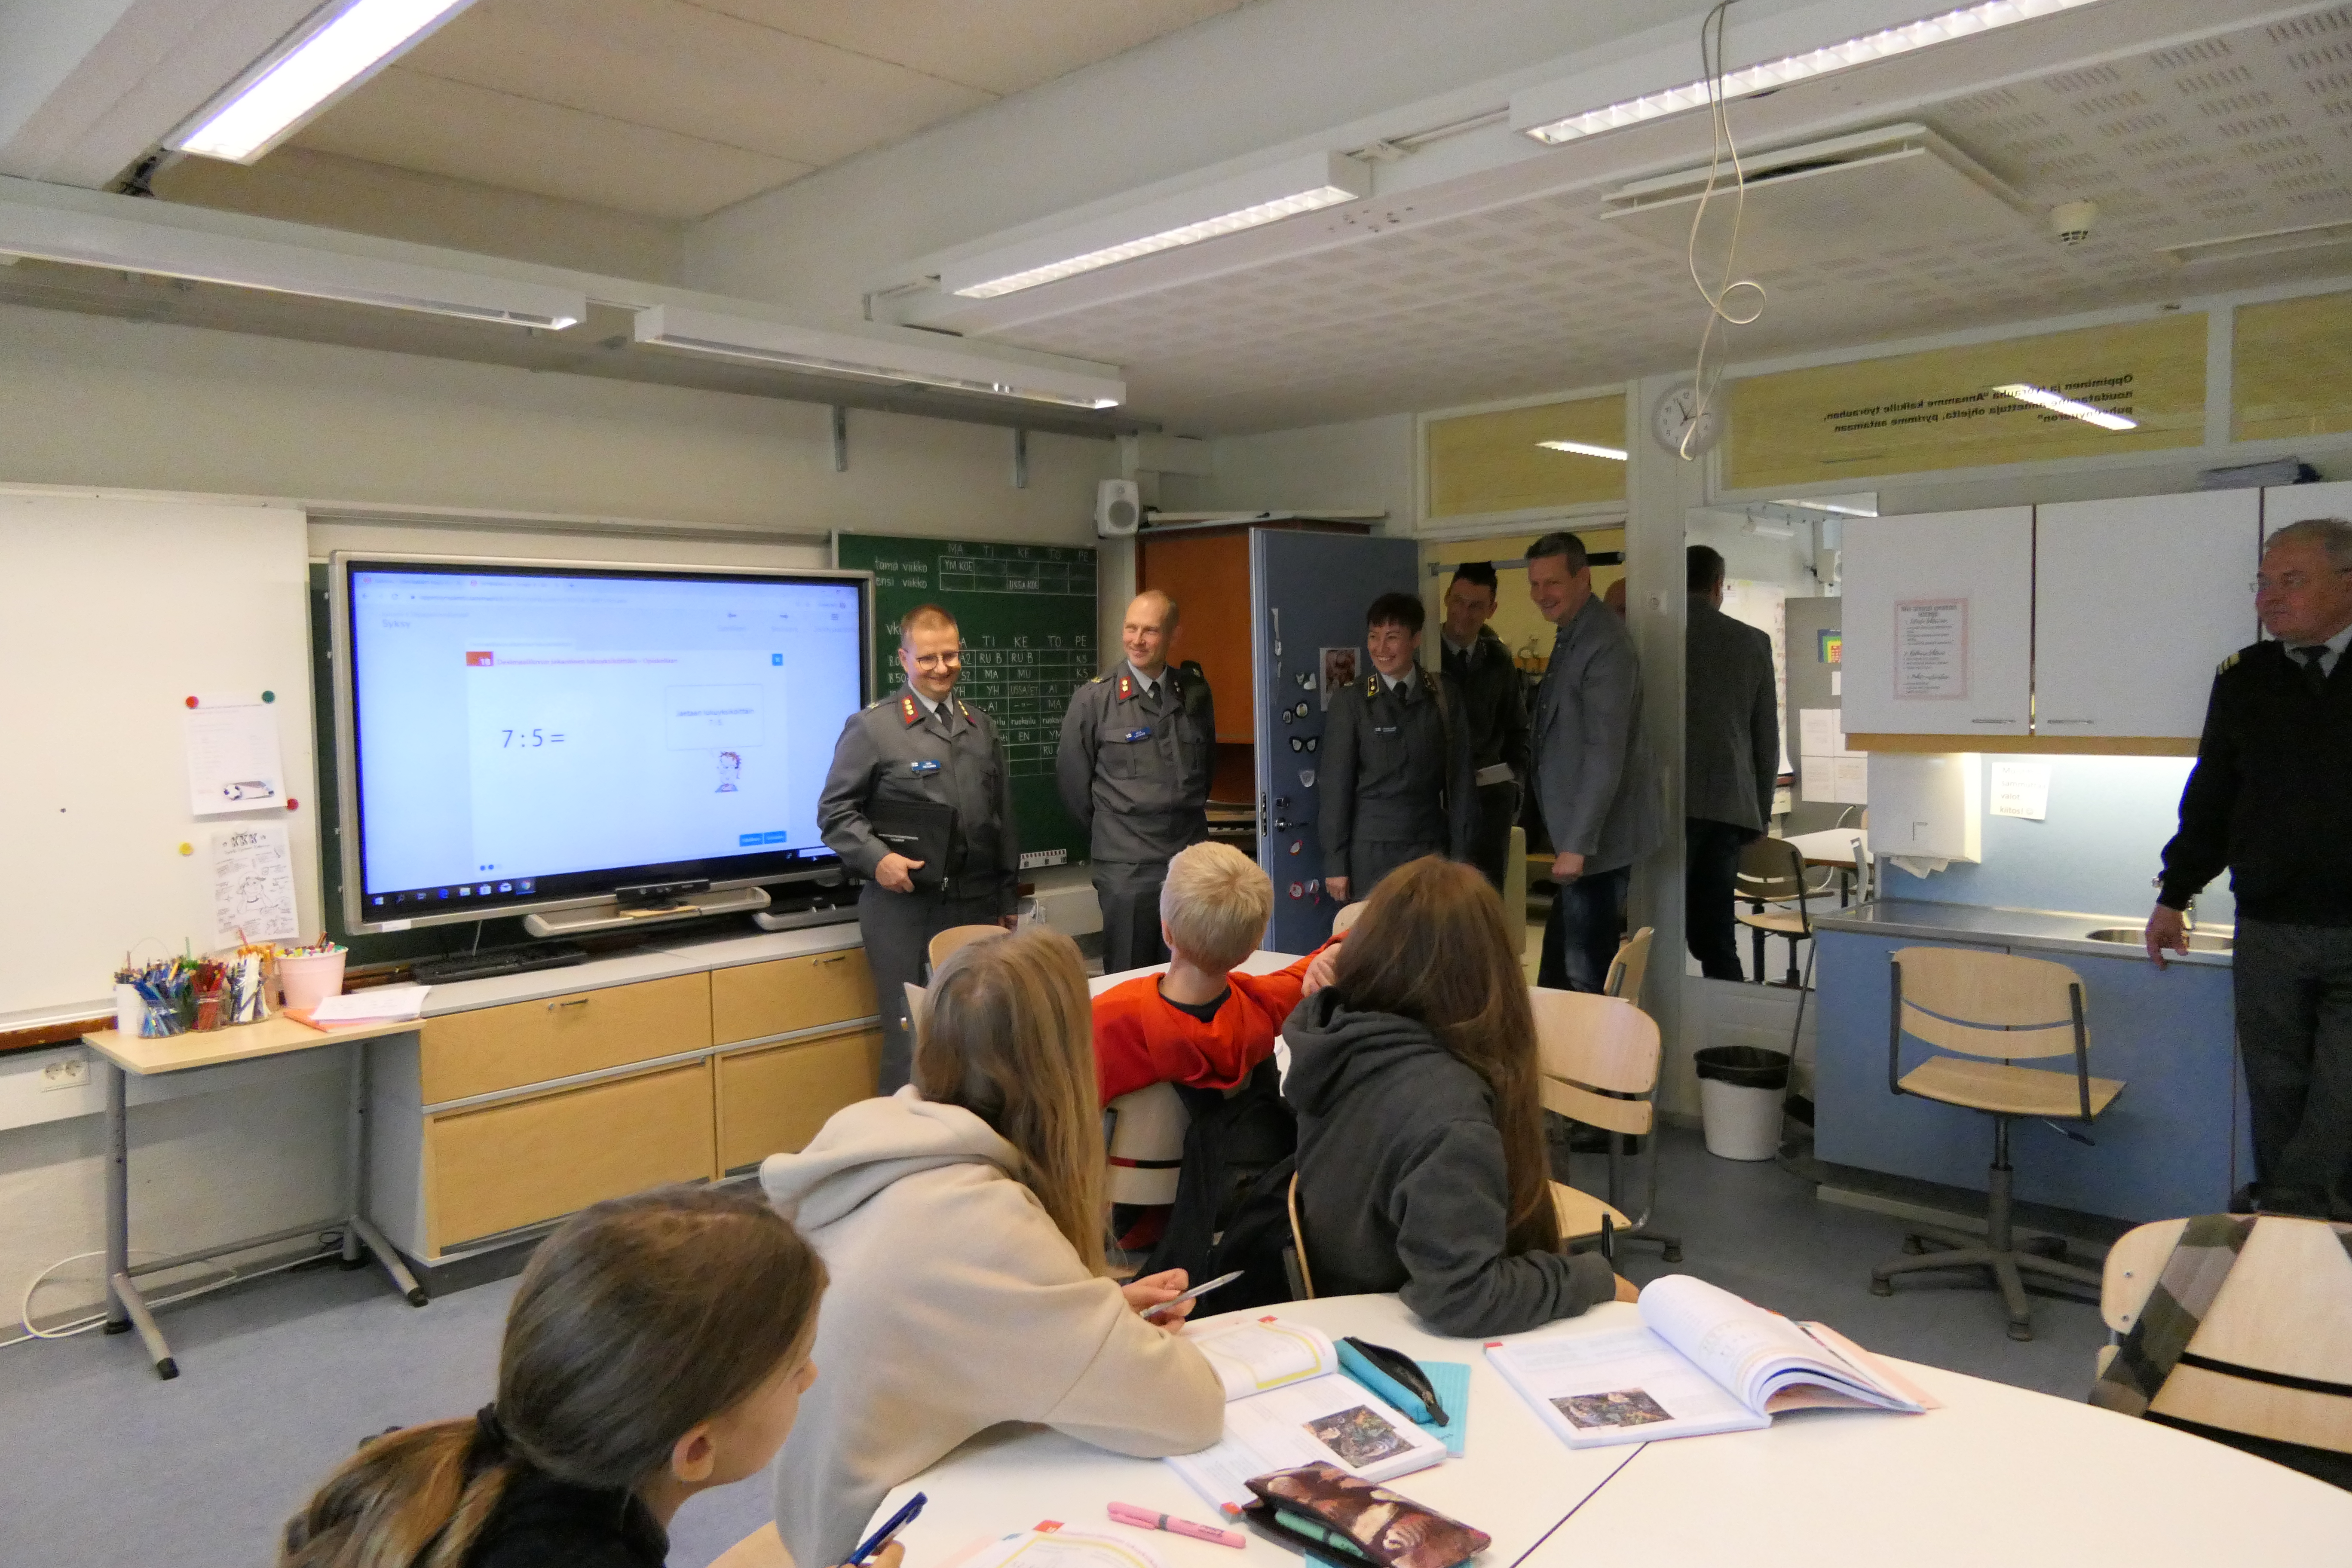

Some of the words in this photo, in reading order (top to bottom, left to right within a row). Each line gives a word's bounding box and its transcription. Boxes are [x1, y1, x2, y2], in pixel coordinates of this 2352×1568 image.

[947, 542, 963, 555] MA
[983, 545, 994, 557] TI
[1018, 548, 1031, 558] KE
[1049, 548, 1061, 560] TO
[903, 560, 927, 573] viikko
[945, 560, 957, 571] YM
[959, 561, 974, 572] KOE
[876, 577, 894, 587] ensi
[903, 577, 927, 589] viikko
[983, 636, 995, 647] TI
[1014, 636, 1029, 648] KE
[1047, 635, 1062, 648] TO
[1075, 635, 1087, 647] PE
[980, 652, 992, 664] RU
[996, 652, 1002, 664] B
[1011, 652, 1023, 663] RU
[1028, 652, 1034, 664] B
[985, 669, 999, 679] MA
[1018, 668, 1031, 679] MU
[987, 685, 999, 696] YH
[1049, 684, 1057, 694] AI
[988, 701, 998, 712] AI
[1048, 699, 1062, 710] MA
[1011, 717, 1036, 726] ruokailu
[1019, 732, 1030, 741] EN
[2000, 805, 2023, 815] kiitos!
